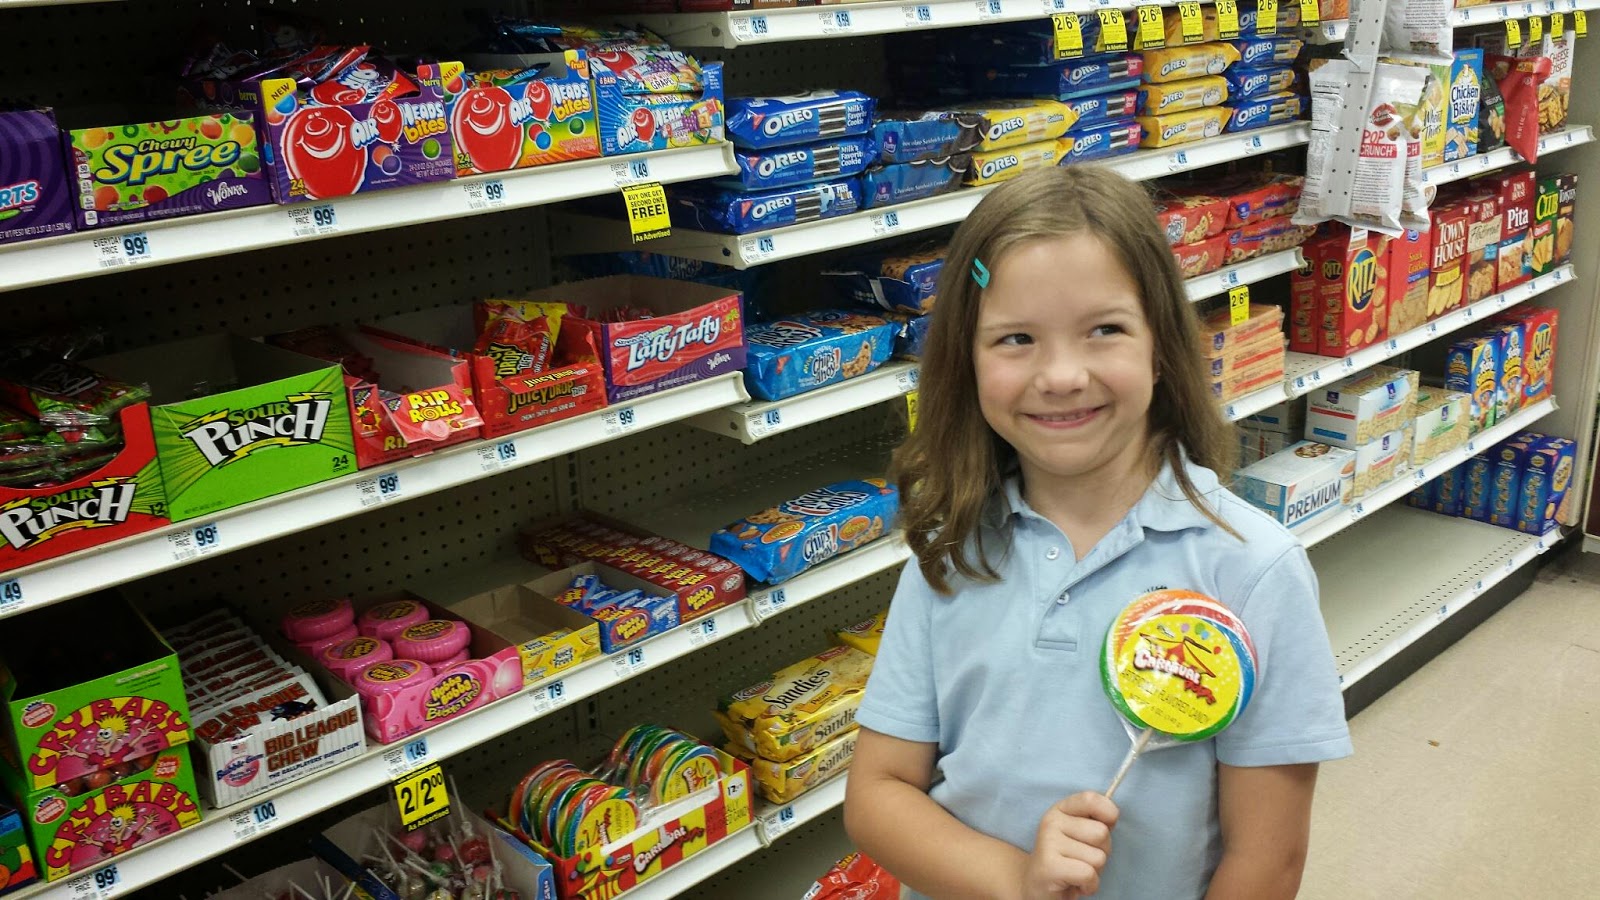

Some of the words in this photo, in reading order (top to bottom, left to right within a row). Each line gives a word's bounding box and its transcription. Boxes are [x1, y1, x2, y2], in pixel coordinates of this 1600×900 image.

[752, 19, 767, 34] 3.59
[836, 12, 850, 27] 3.59
[1243, 42, 1273, 62] OREO
[443, 65, 460, 81] NEW
[570, 58, 587, 71] fruit
[1161, 59, 1187, 75] OREO
[270, 83, 291, 101] NEW
[423, 77, 441, 88] berry
[650, 78, 675, 90] GRAPE
[1243, 74, 1268, 93] OREO
[510, 98, 531, 125] AIR
[551, 82, 588, 103] HEADS
[1160, 91, 1184, 107] OREO
[1451, 85, 1478, 103] Chicken
[553, 97, 591, 120] bites
[1072, 100, 1099, 117] OREO
[1237, 104, 1268, 126] OREO
[1453, 101, 1476, 120] Biskit
[351, 118, 380, 150] AIR
[401, 101, 444, 127] HEADS
[403, 117, 448, 143] bites
[764, 109, 813, 138] OREO
[847, 118, 864, 127] Cookie
[988, 117, 1024, 140] OREO
[1163, 122, 1187, 140] OREO
[138, 136, 197, 153] Chewy
[617, 123, 638, 149] AIR
[1074, 132, 1102, 153] OREO
[1362, 129, 1385, 144] POP
[458, 153, 470, 163] 24
[1360, 144, 1392, 157] CRUNCH
[95, 140, 241, 186] Spree
[633, 163, 649, 178] 1.49
[758, 150, 807, 178] OREO
[841, 158, 862, 166] Cookie
[982, 155, 1018, 178] OREO
[291, 179, 304, 191] 24
[640, 191, 651, 199] ONE
[652, 189, 663, 197] GET
[288, 207, 312, 219] EVERYDAY
[630, 199, 652, 208] SECOND
[632, 203, 666, 220] FREE!
[751, 196, 792, 219] OREO
[295, 215, 310, 225] PRICE
[1507, 207, 1529, 229] Pita
[635, 234, 643, 242] As
[644, 229, 671, 240] Advertised
[1439, 219, 1466, 245] TOWN
[93, 237, 121, 248] EVERYDAY
[101, 246, 119, 255] PRICE
[1433, 238, 1466, 269] HOUSE
[1350, 256, 1377, 306] RITZ
[627, 333, 678, 371] Laffy
[675, 316, 720, 350] Taffy
[813, 352, 835, 375] Chips
[524, 373, 555, 388] JUICY
[508, 386, 550, 414] JUICY
[550, 381, 574, 398] DROP
[229, 402, 291, 427] SOUR
[408, 402, 463, 423] ROLLS
[185, 400, 331, 467] PUNCH
[499, 442, 516, 460] 1.99
[332, 454, 349, 468] 24
[31, 487, 96, 512] SOUR
[150, 502, 164, 516] 12
[1286, 479, 1341, 523] PREMIUM
[0, 483, 137, 550] PUNCH
[175, 538, 191, 547] PRICE
[804, 529, 831, 560] Chips
[687, 588, 709, 606] Hubba
[616, 616, 640, 635] Hubba
[623, 618, 647, 640] Bubba
[431, 675, 462, 702] Hubba
[441, 679, 472, 705] Bubba
[763, 668, 831, 710] Sandies
[810, 690, 831, 706] Pecan
[264, 730, 295, 755] BIG
[299, 706, 358, 743] LEAGUE
[815, 707, 858, 744] Sandie
[28, 709, 84, 777] CRY
[91, 696, 190, 735] BABY
[267, 740, 319, 773] CHEW
[410, 742, 426, 760] 1.49
[817, 740, 855, 773] Sandie
[156, 766, 177, 776] SOUR
[269, 771, 281, 779] THE
[253, 801, 276, 822] 1.00
[417, 808, 450, 827] Advertised
[46, 797, 98, 869] CRY
[103, 780, 197, 815] BABY
